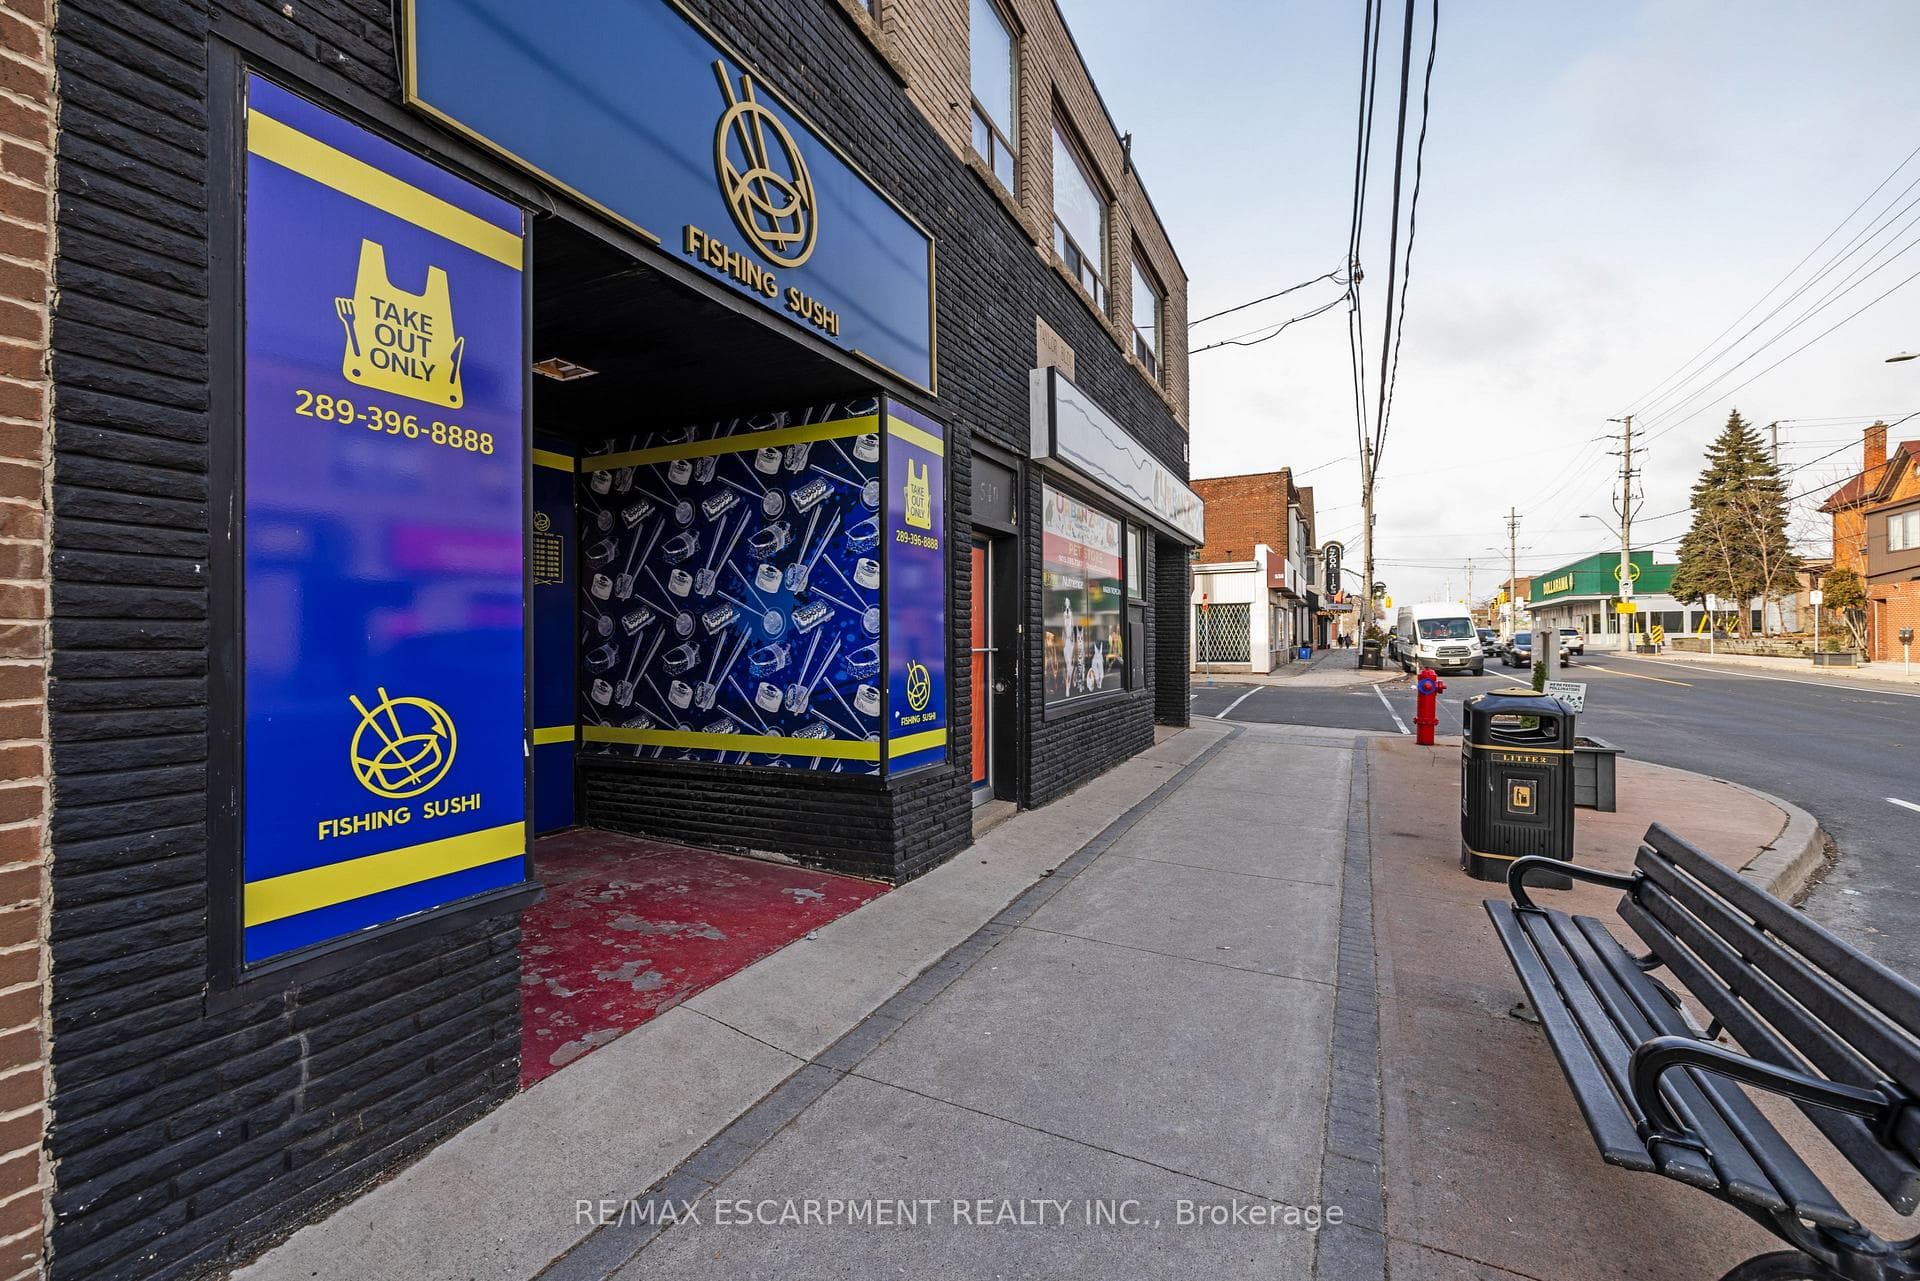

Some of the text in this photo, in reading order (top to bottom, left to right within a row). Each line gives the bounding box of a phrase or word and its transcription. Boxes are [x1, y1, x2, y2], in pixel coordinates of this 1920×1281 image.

[684, 224, 840, 336] FISHING SUSHI
[370, 296, 433, 335] TAKE
[374, 323, 432, 357] OUT
[370, 347, 436, 382] ONLY
[295, 389, 495, 455] 289-396-8888
[910, 483, 925, 497] TAKE
[911, 495, 925, 508] OUT
[910, 506, 926, 519] ONLY
[895, 530, 939, 550] 289-396-8888
[900, 712, 937, 726] FISHING SUSHI
[1503, 754, 1547, 763] LITTER
[318, 793, 481, 841] FISHING SUSHI
